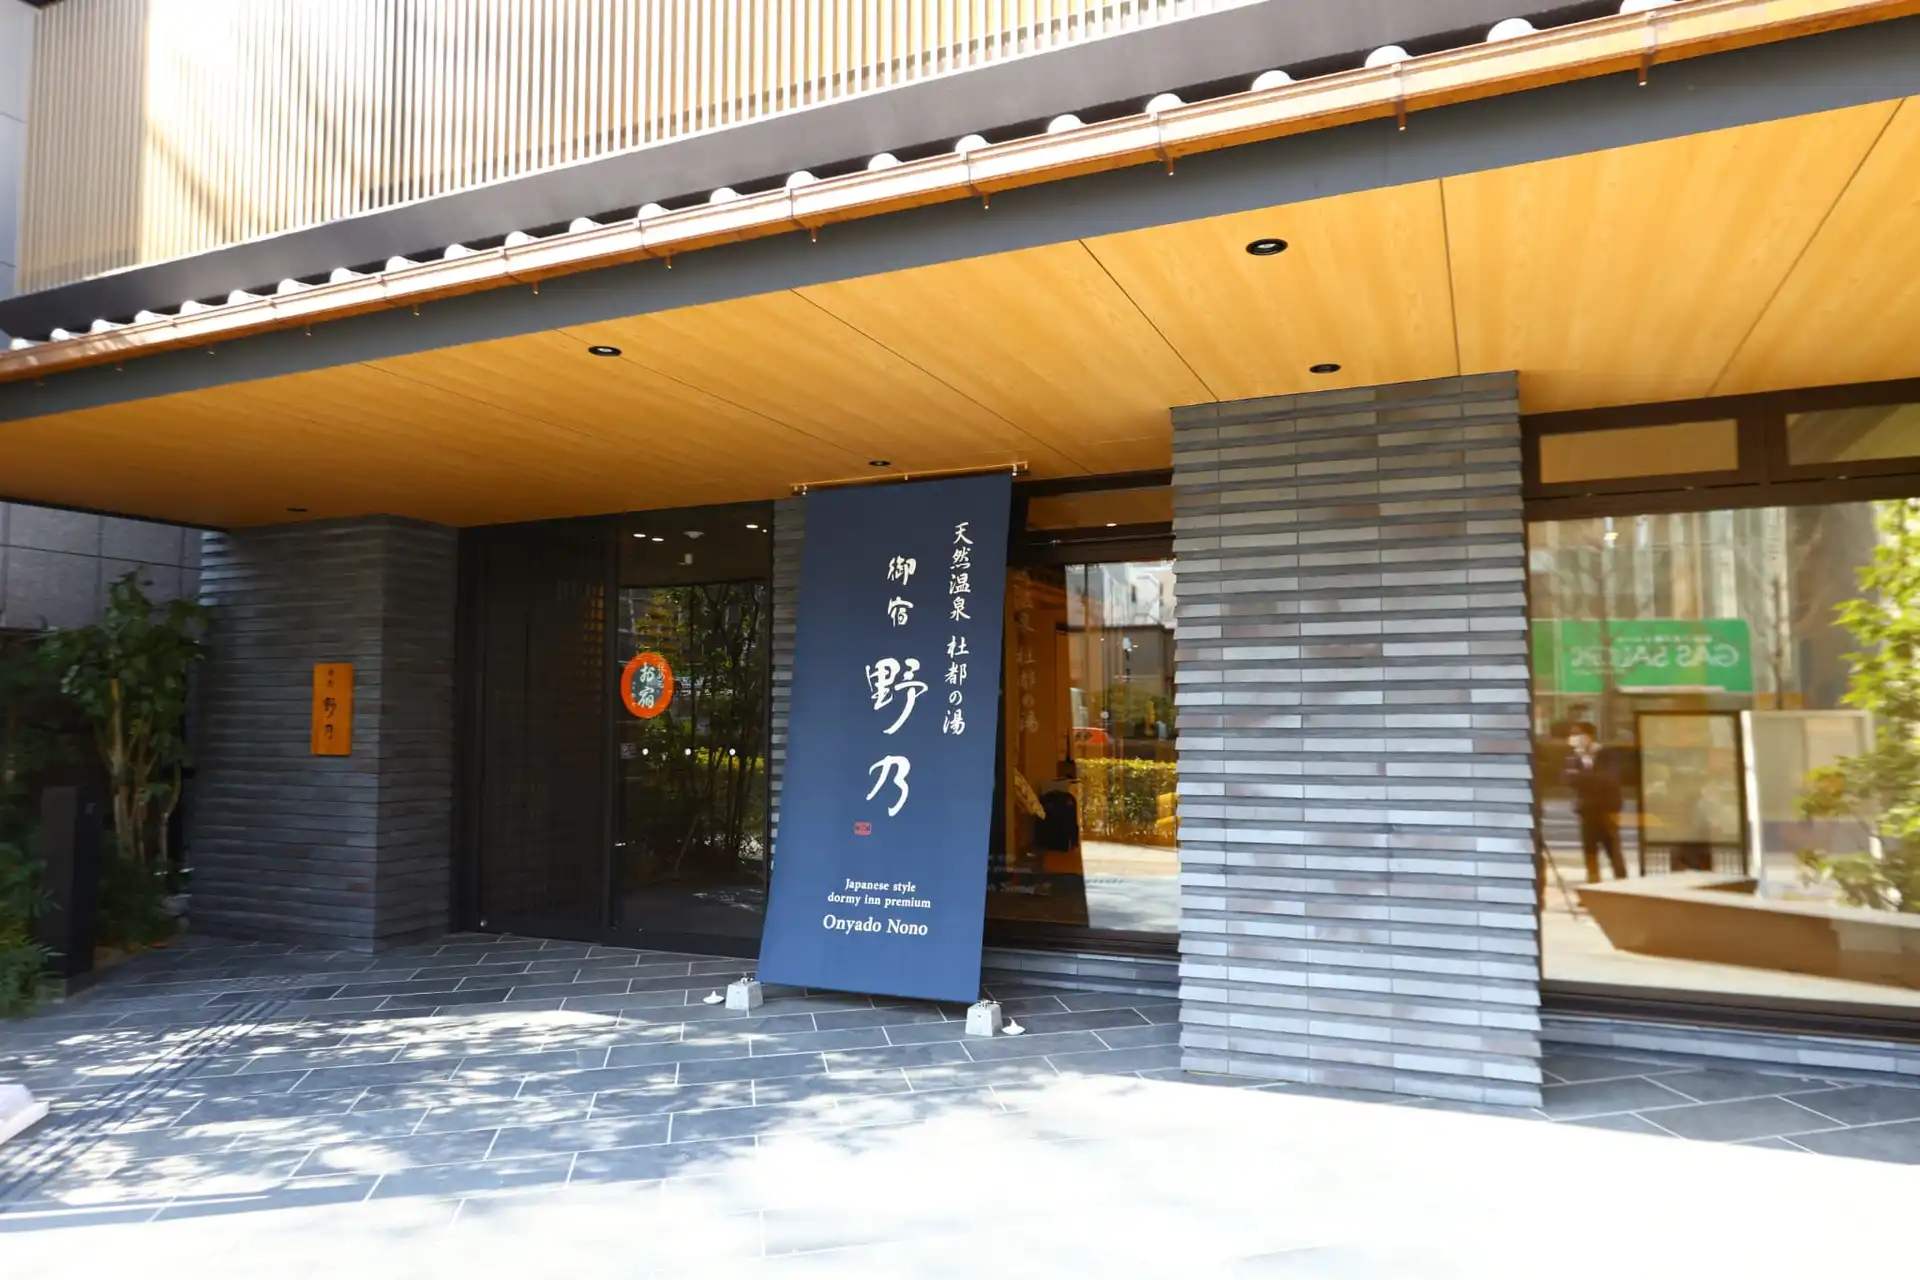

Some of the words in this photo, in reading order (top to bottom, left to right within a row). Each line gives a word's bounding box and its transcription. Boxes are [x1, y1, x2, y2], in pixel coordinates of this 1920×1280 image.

[887, 556, 917, 628] 御宿
[948, 521, 974, 622] 天然温泉
[638, 662, 656, 709] お宿
[942, 634, 970, 736] 杜都の湯
[865, 657, 929, 818] 野乃
[827, 892, 861, 907] dormy
[864, 894, 881, 905] inn
[884, 897, 931, 909] premium
[845, 878, 890, 892] Japanese
[893, 881, 916, 895] style
[823, 914, 882, 935] Onyado
[886, 919, 929, 936] Nono
